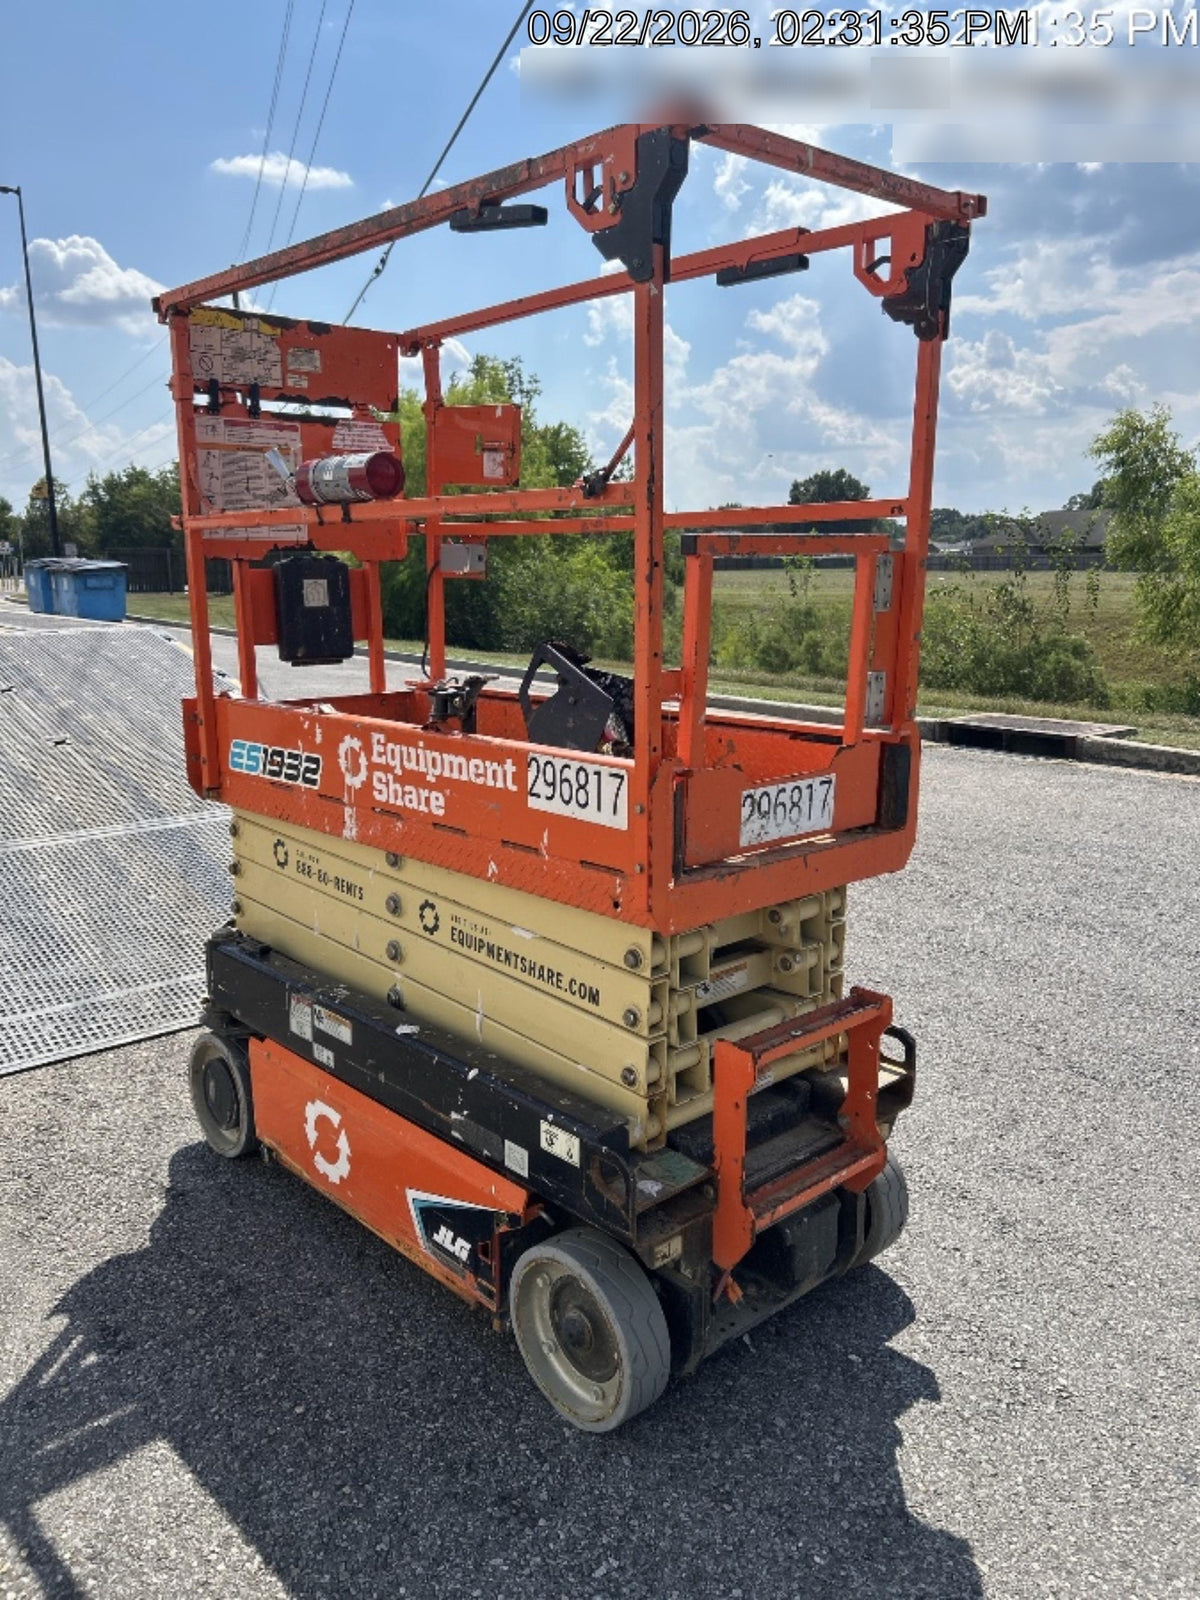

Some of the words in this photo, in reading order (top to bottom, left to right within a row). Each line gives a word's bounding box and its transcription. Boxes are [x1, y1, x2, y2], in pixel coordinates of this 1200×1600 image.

[230, 740, 321, 789] ES1932
[371, 732, 518, 791] Equipment
[528, 757, 625, 815] 296817
[372, 771, 445, 816] Share
[742, 778, 832, 828] 296817
[450, 926, 601, 1007] EQUIPMENTSHARE.COM
[432, 1224, 472, 1262] JLG
